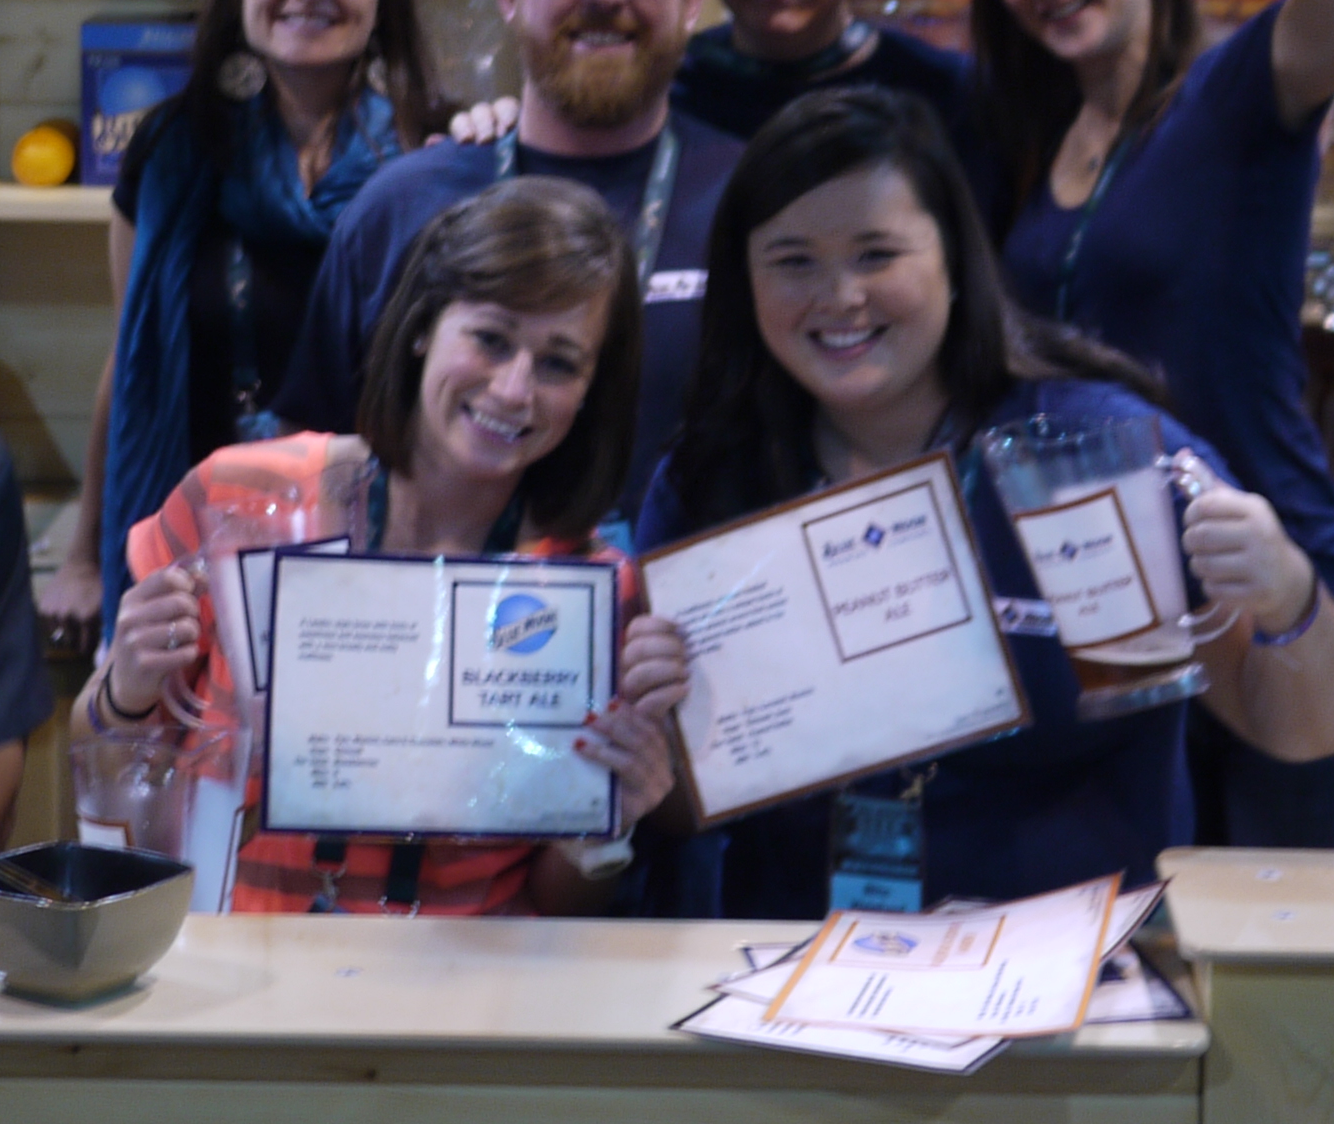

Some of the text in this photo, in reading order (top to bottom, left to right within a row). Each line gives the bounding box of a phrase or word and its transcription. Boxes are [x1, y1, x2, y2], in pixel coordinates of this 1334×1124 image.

[461, 669, 580, 686] BLACKBERRY
[478, 690, 560, 708] TART ALE
